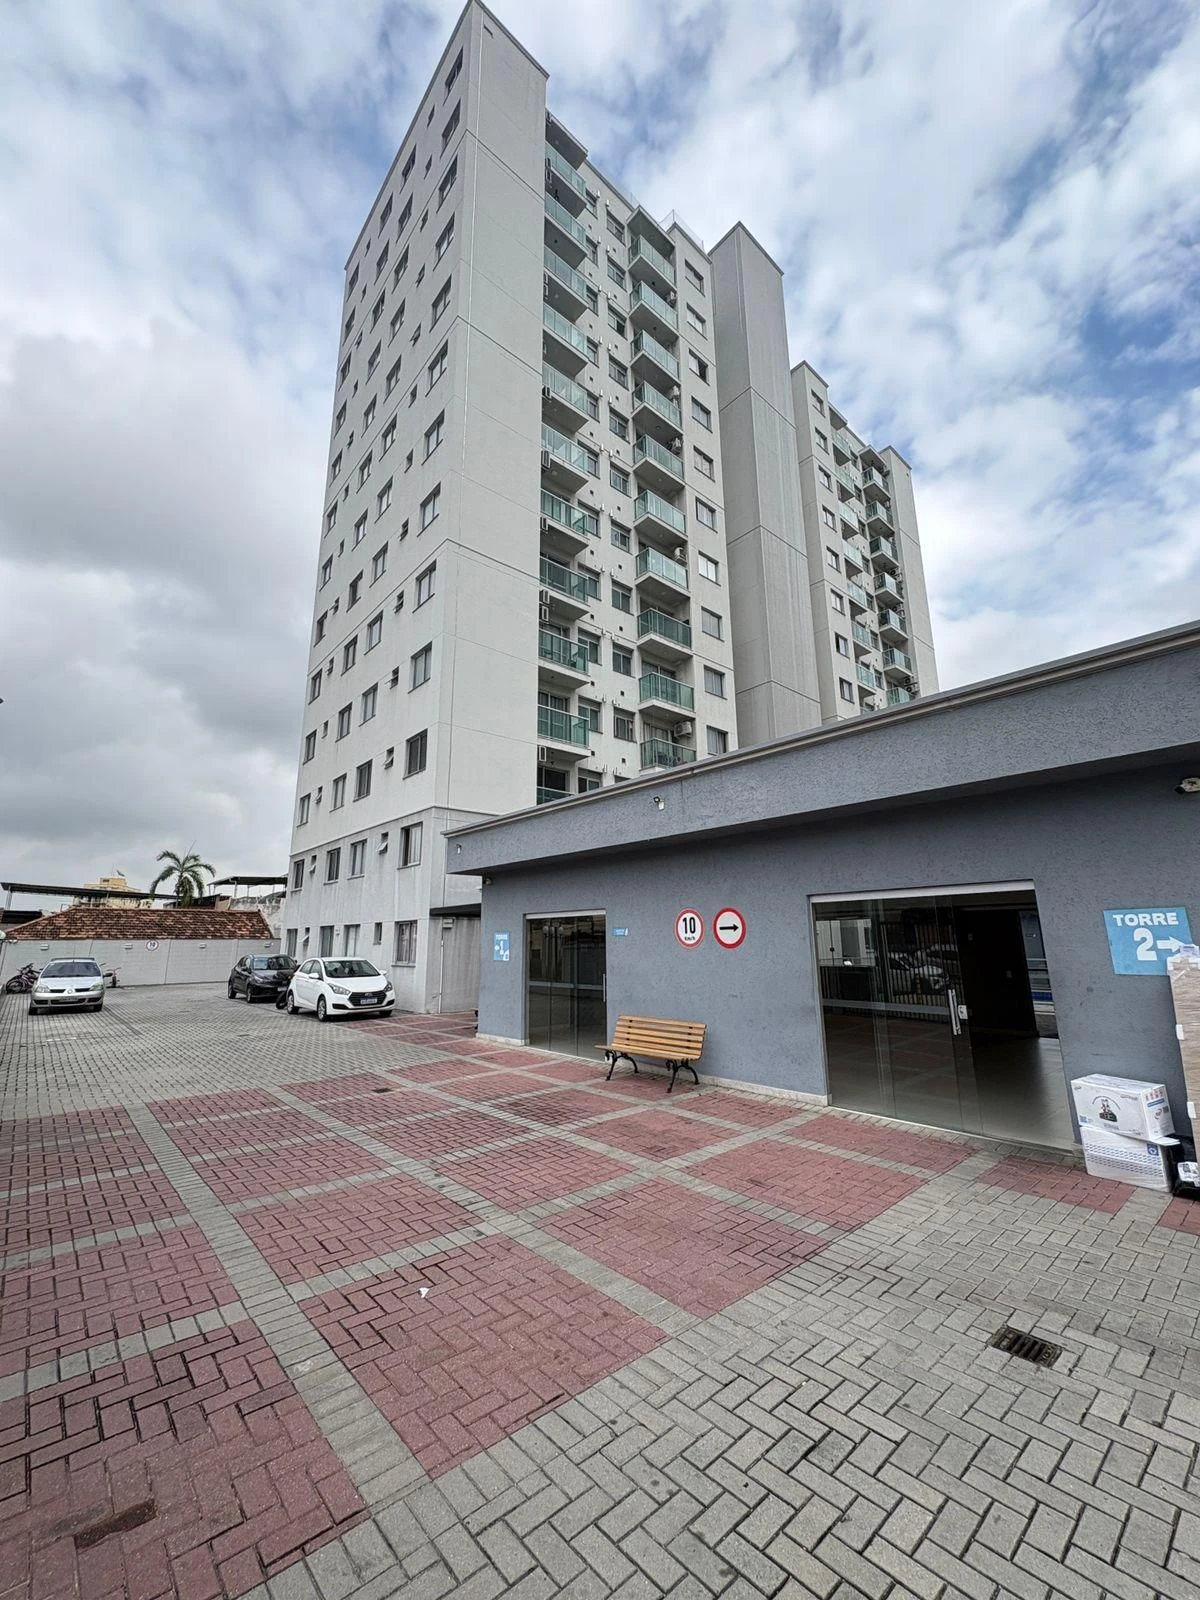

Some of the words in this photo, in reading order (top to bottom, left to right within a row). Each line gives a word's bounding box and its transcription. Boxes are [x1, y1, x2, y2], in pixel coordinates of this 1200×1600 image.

[682, 916, 696, 934] 10
[1112, 912, 1179, 926] TORRE
[1133, 927, 1158, 961] 2
